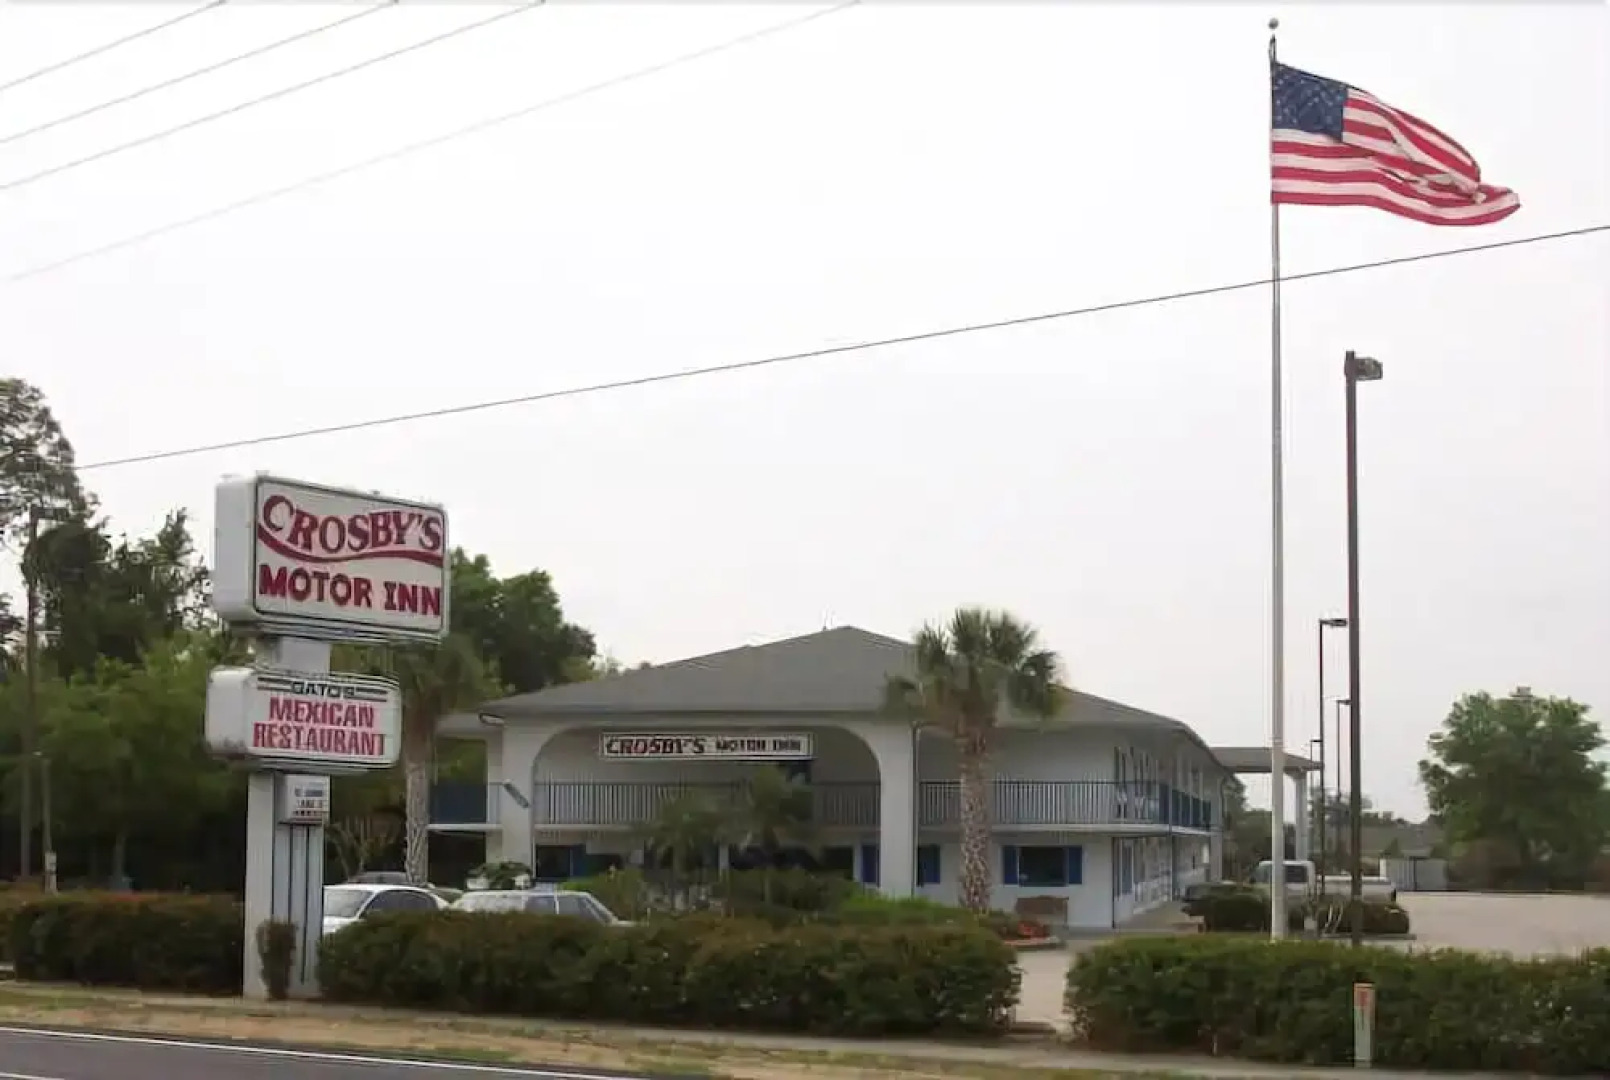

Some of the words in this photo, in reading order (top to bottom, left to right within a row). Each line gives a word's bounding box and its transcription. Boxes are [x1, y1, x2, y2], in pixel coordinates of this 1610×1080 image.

[263, 495, 442, 553] CROSBY'S
[258, 563, 372, 608] MOTOR
[383, 580, 442, 616] INN
[269, 697, 374, 727] MEXICAN
[253, 722, 386, 756] RESTAURANT
[606, 738, 705, 754] CROSBY'S
